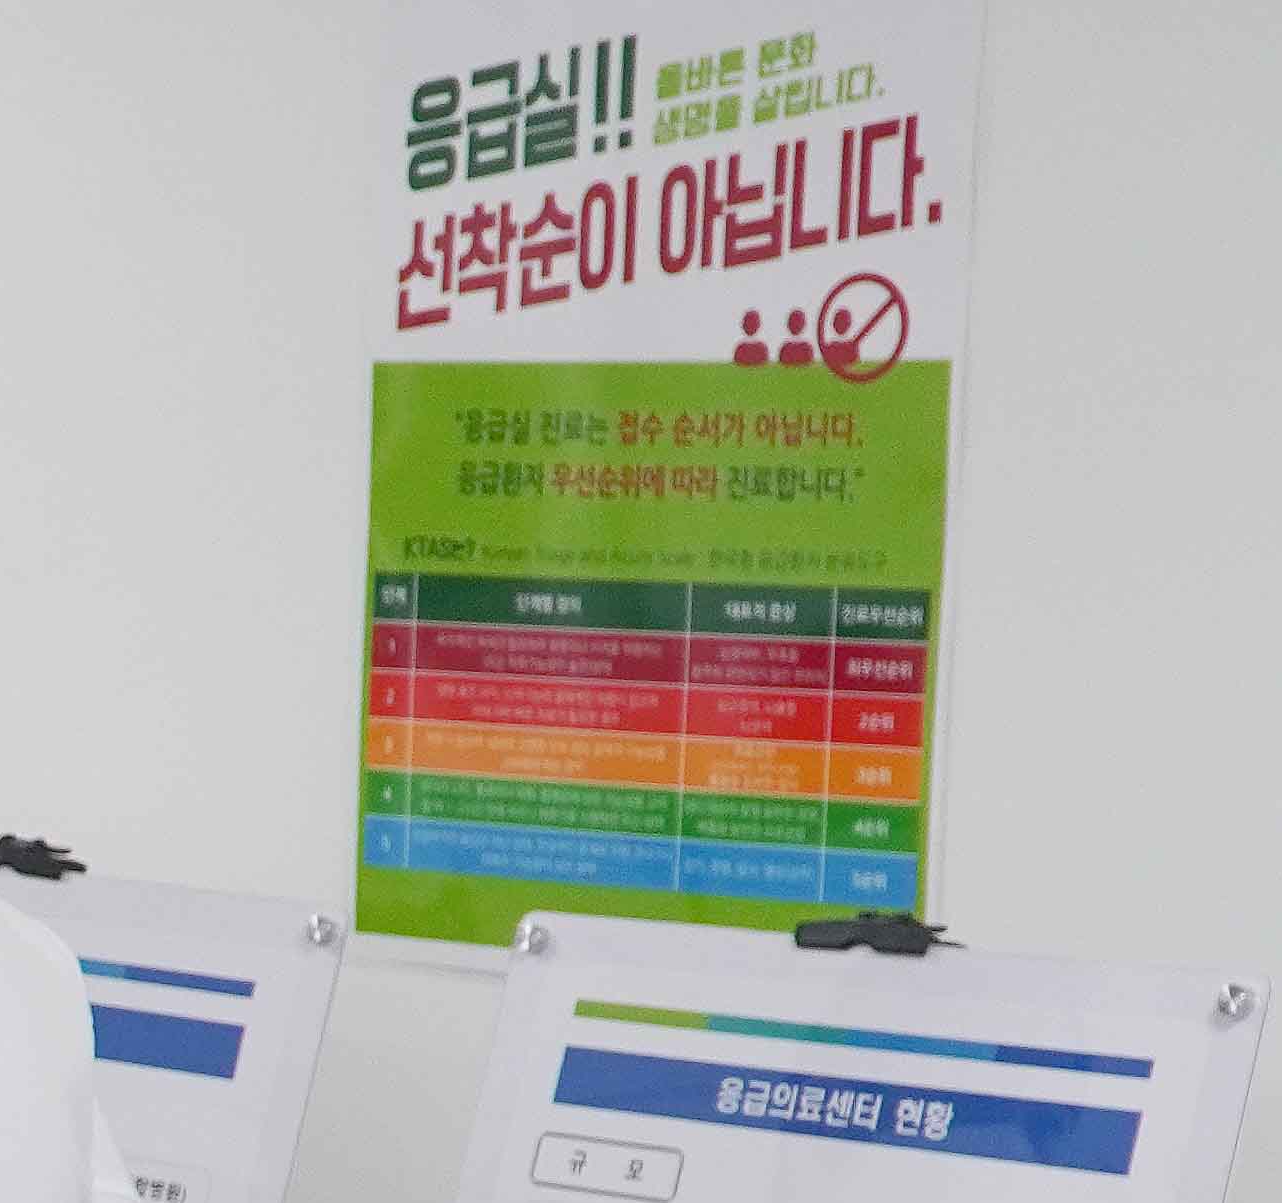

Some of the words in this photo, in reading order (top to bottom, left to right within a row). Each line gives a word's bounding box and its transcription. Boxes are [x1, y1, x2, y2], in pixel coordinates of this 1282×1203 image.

[656, 48, 745, 100] 올바른
[758, 31, 816, 80] 문화
[407, 35, 637, 191] 응급실!!
[653, 95, 742, 145] 생명을
[753, 62, 886, 125] 살립니다.
[396, 175, 638, 330] 선착순이
[658, 113, 943, 274] 아닙니다.
[618, 409, 663, 447] 접수
[673, 409, 747, 449] 순서가
[755, 411, 865, 448] 아닙니다.
[458, 461, 545, 498] 응급환자
[553, 462, 666, 500] 우선순위에
[670, 464, 719, 500] 따라
[716, 1076, 883, 1131] 응급의료센터
[894, 1096, 955, 1142] 현황
